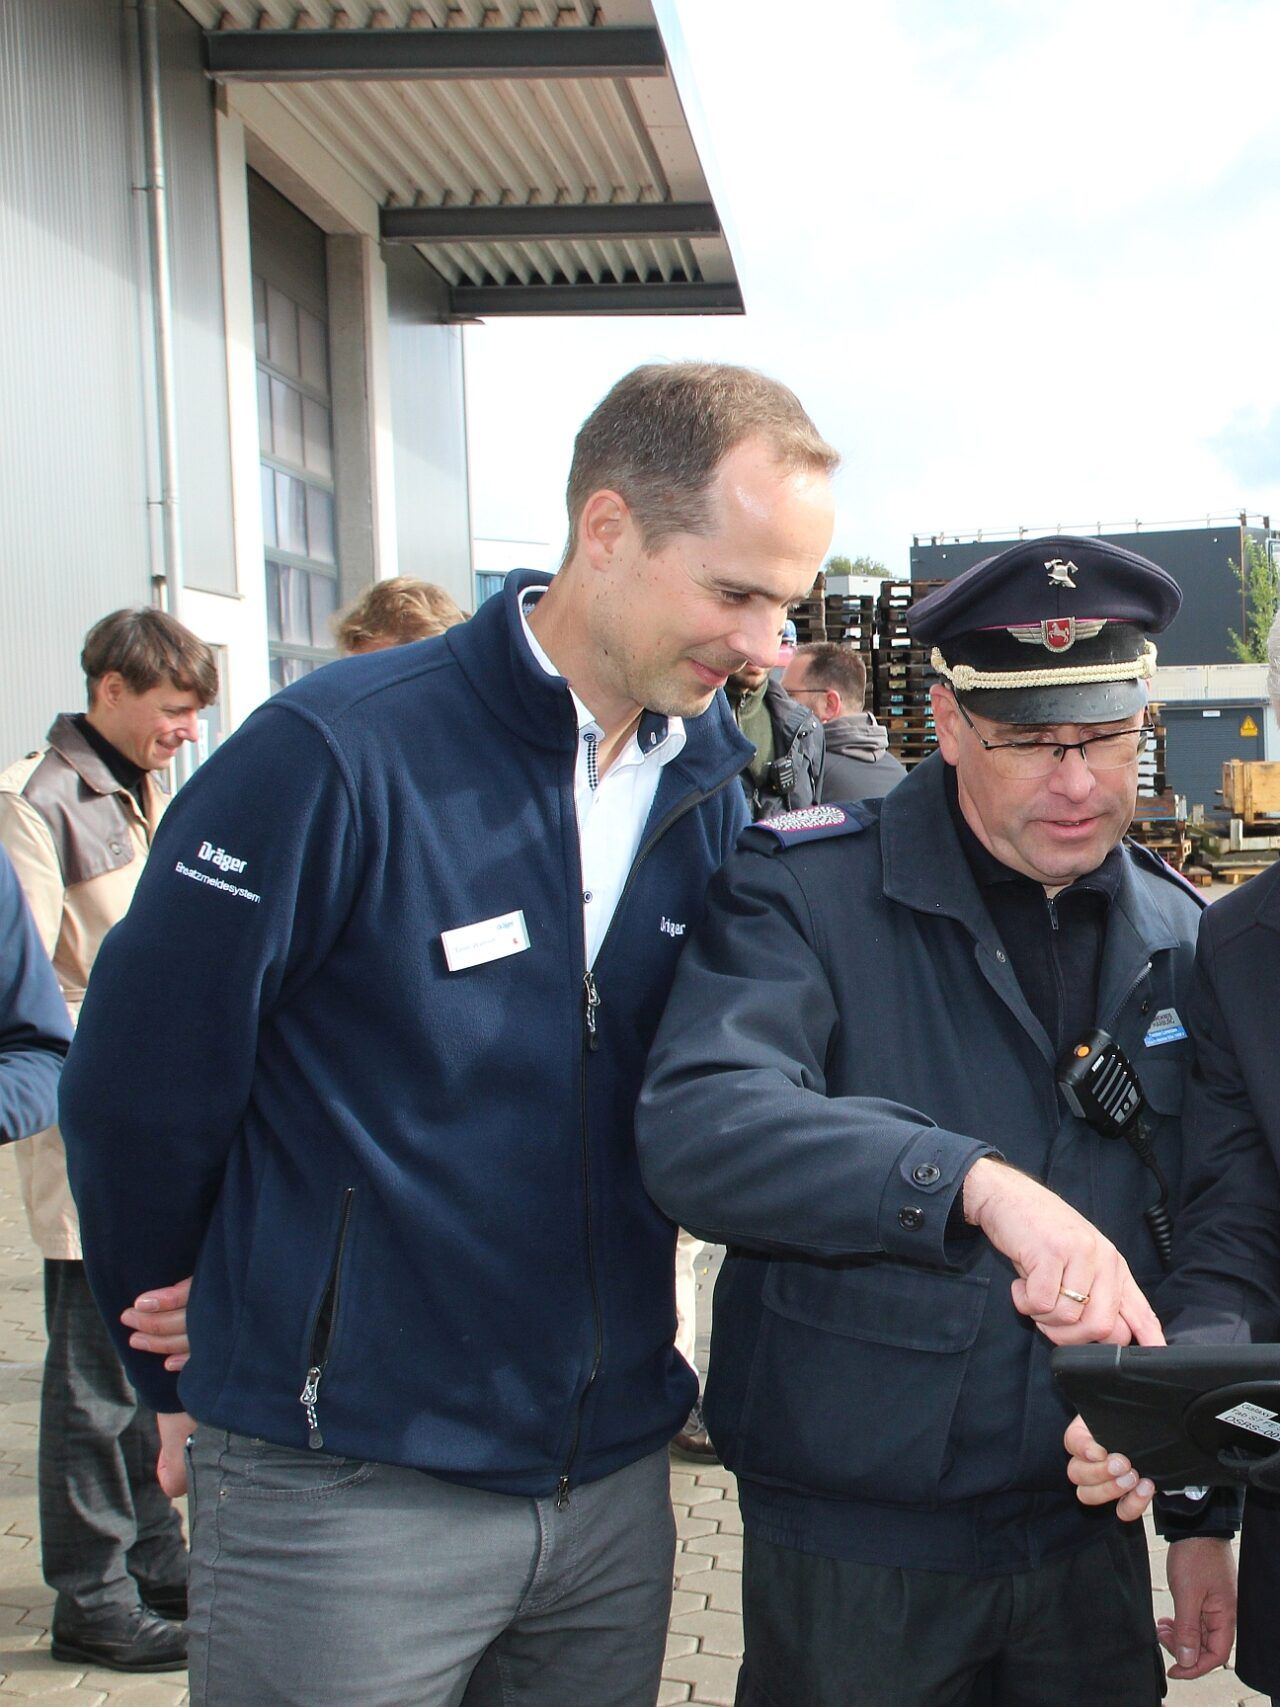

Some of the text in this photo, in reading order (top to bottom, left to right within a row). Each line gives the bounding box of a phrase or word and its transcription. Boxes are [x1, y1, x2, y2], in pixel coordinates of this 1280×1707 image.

[198, 841, 247, 873] Dräger
[1231, 1408, 1248, 1418] Tab
[1241, 1404, 1273, 1418] Galaxy
